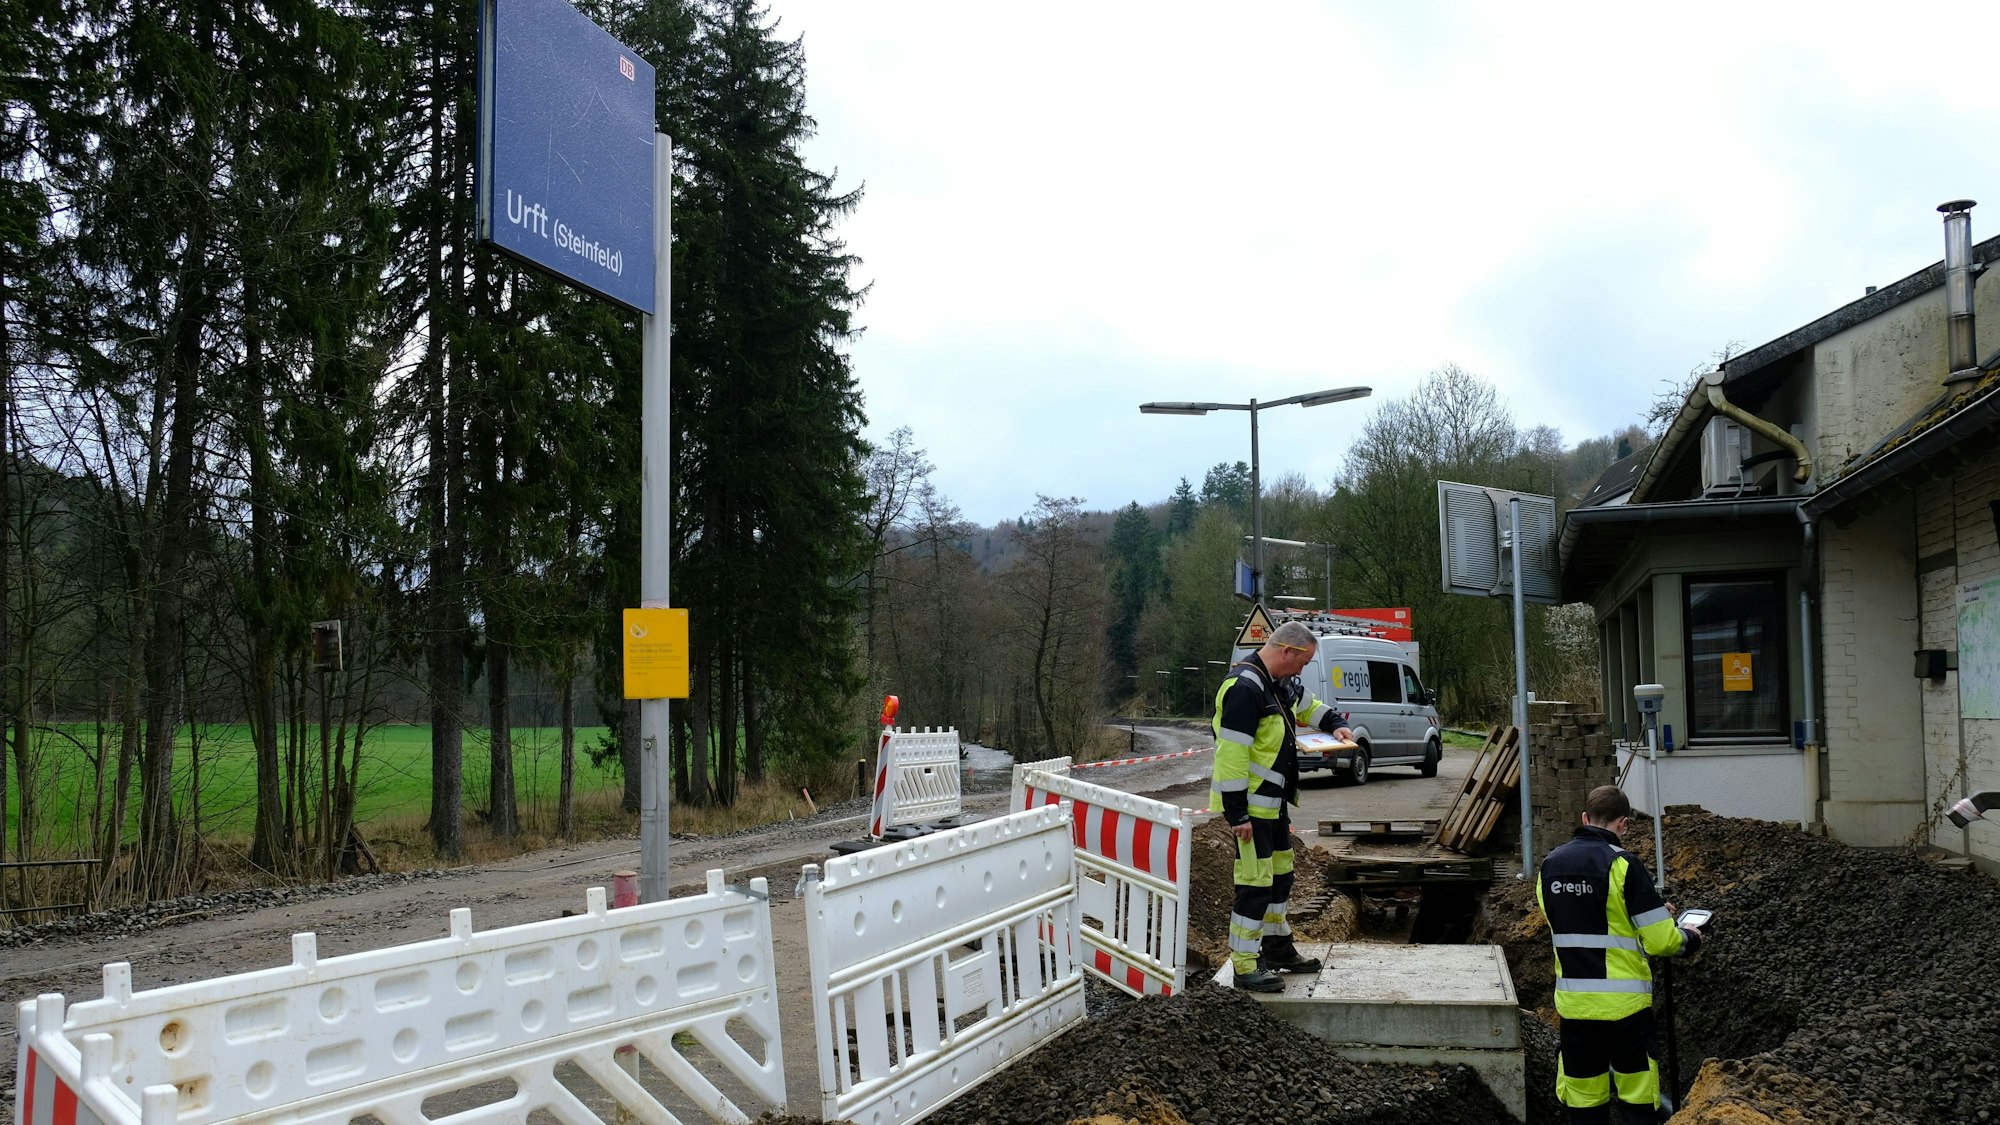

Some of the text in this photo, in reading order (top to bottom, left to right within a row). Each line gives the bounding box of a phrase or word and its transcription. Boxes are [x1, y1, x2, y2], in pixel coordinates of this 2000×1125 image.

[621, 59, 633, 78] DB
[507, 188, 623, 276] Urft (Steinfeld)
